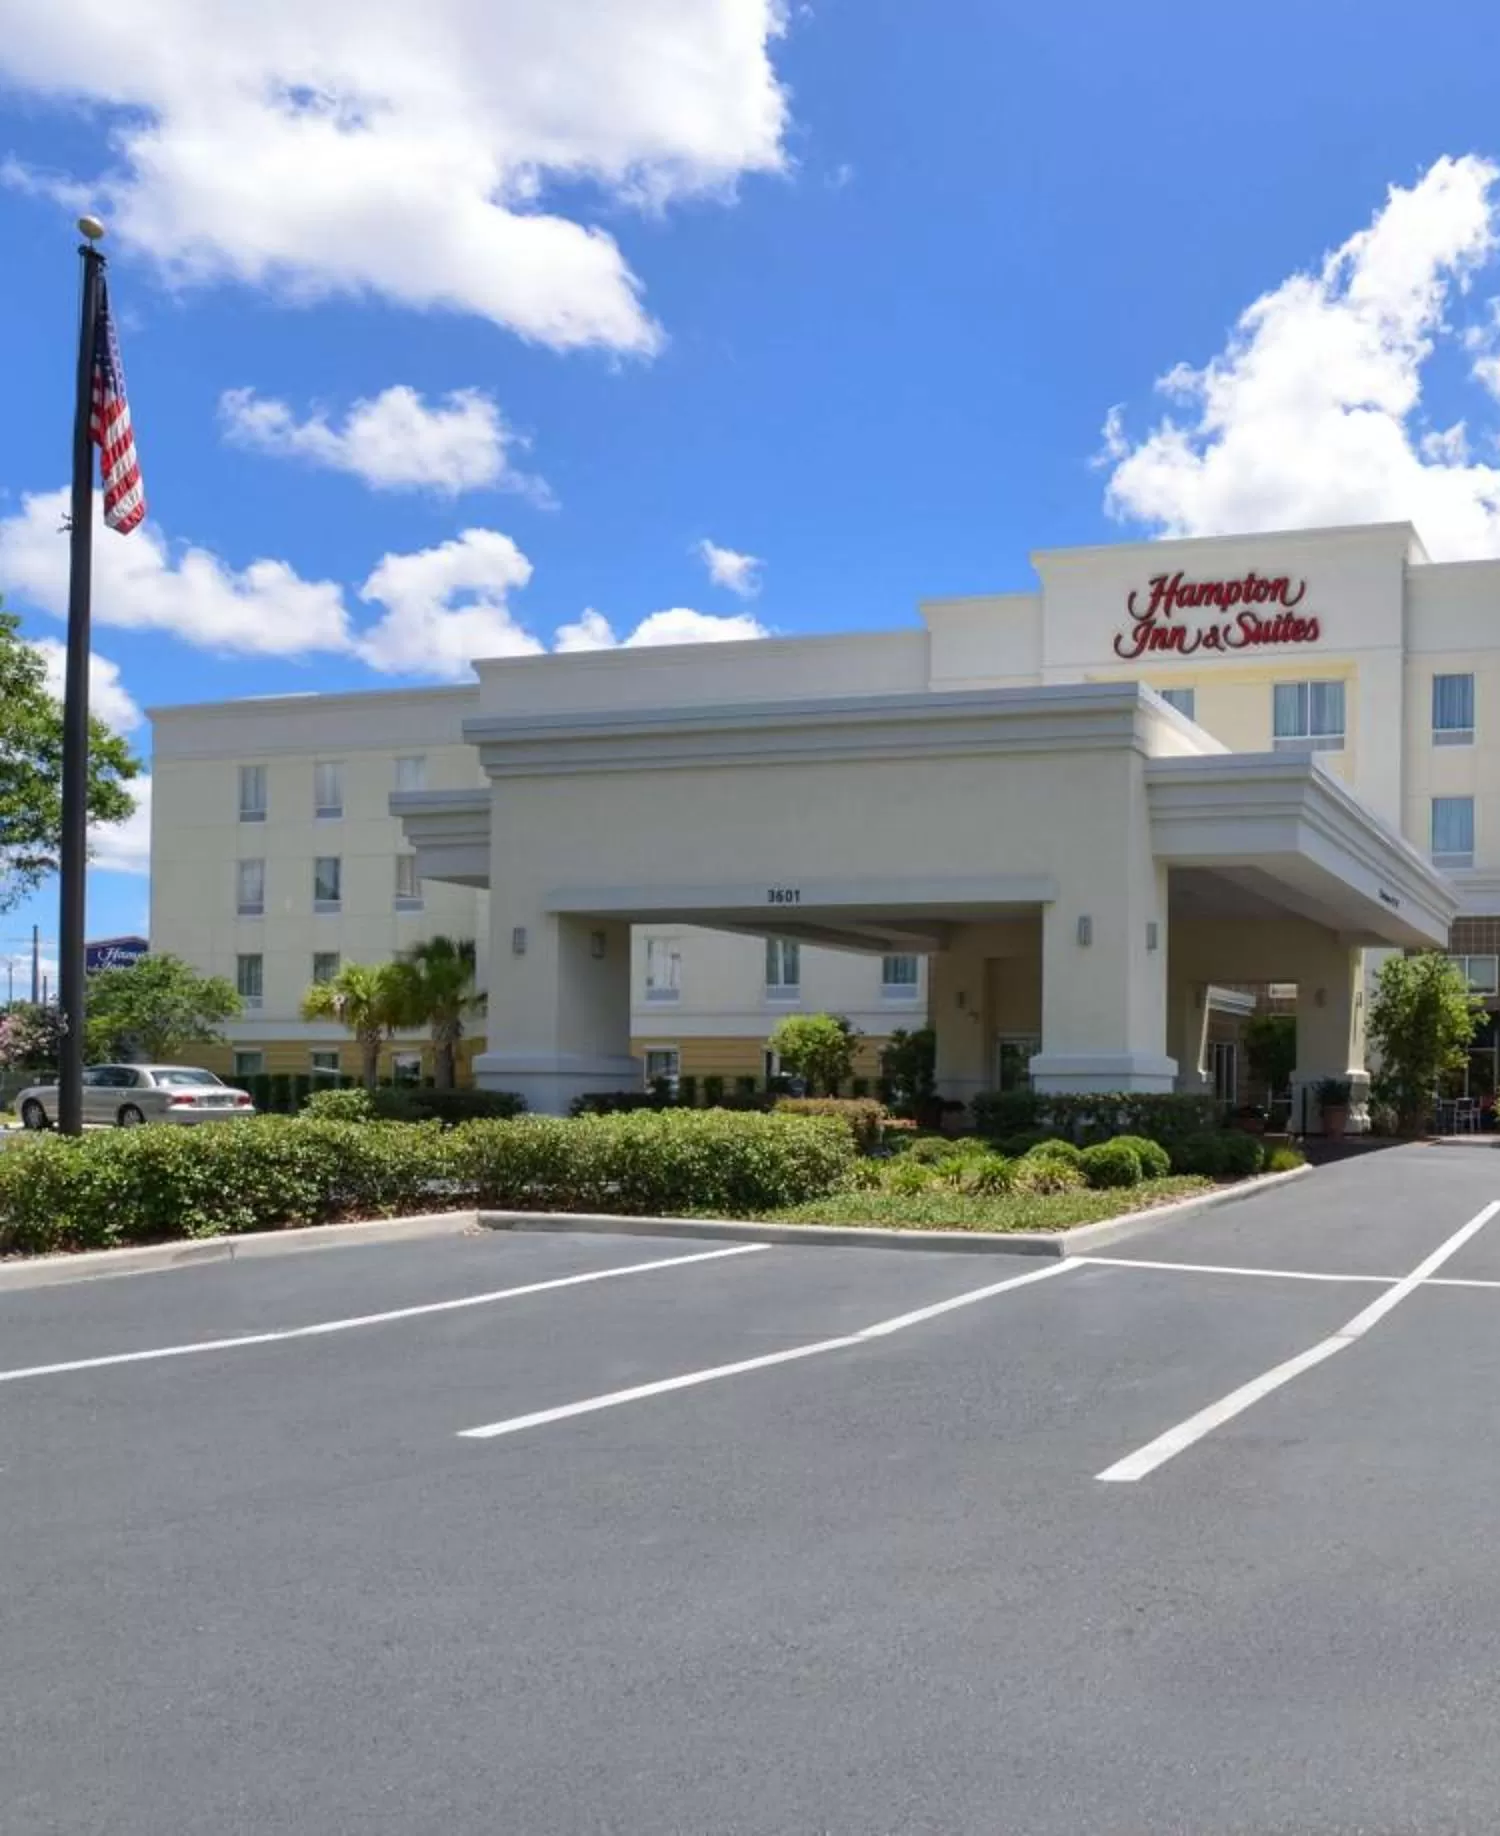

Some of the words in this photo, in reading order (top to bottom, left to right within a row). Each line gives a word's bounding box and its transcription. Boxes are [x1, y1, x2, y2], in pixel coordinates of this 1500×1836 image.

[1128, 571, 1305, 621] Hampton
[1114, 618, 1202, 659] Inn
[1202, 625, 1224, 651] &
[1223, 611, 1320, 649] Suites
[767, 889, 801, 903] 3601
